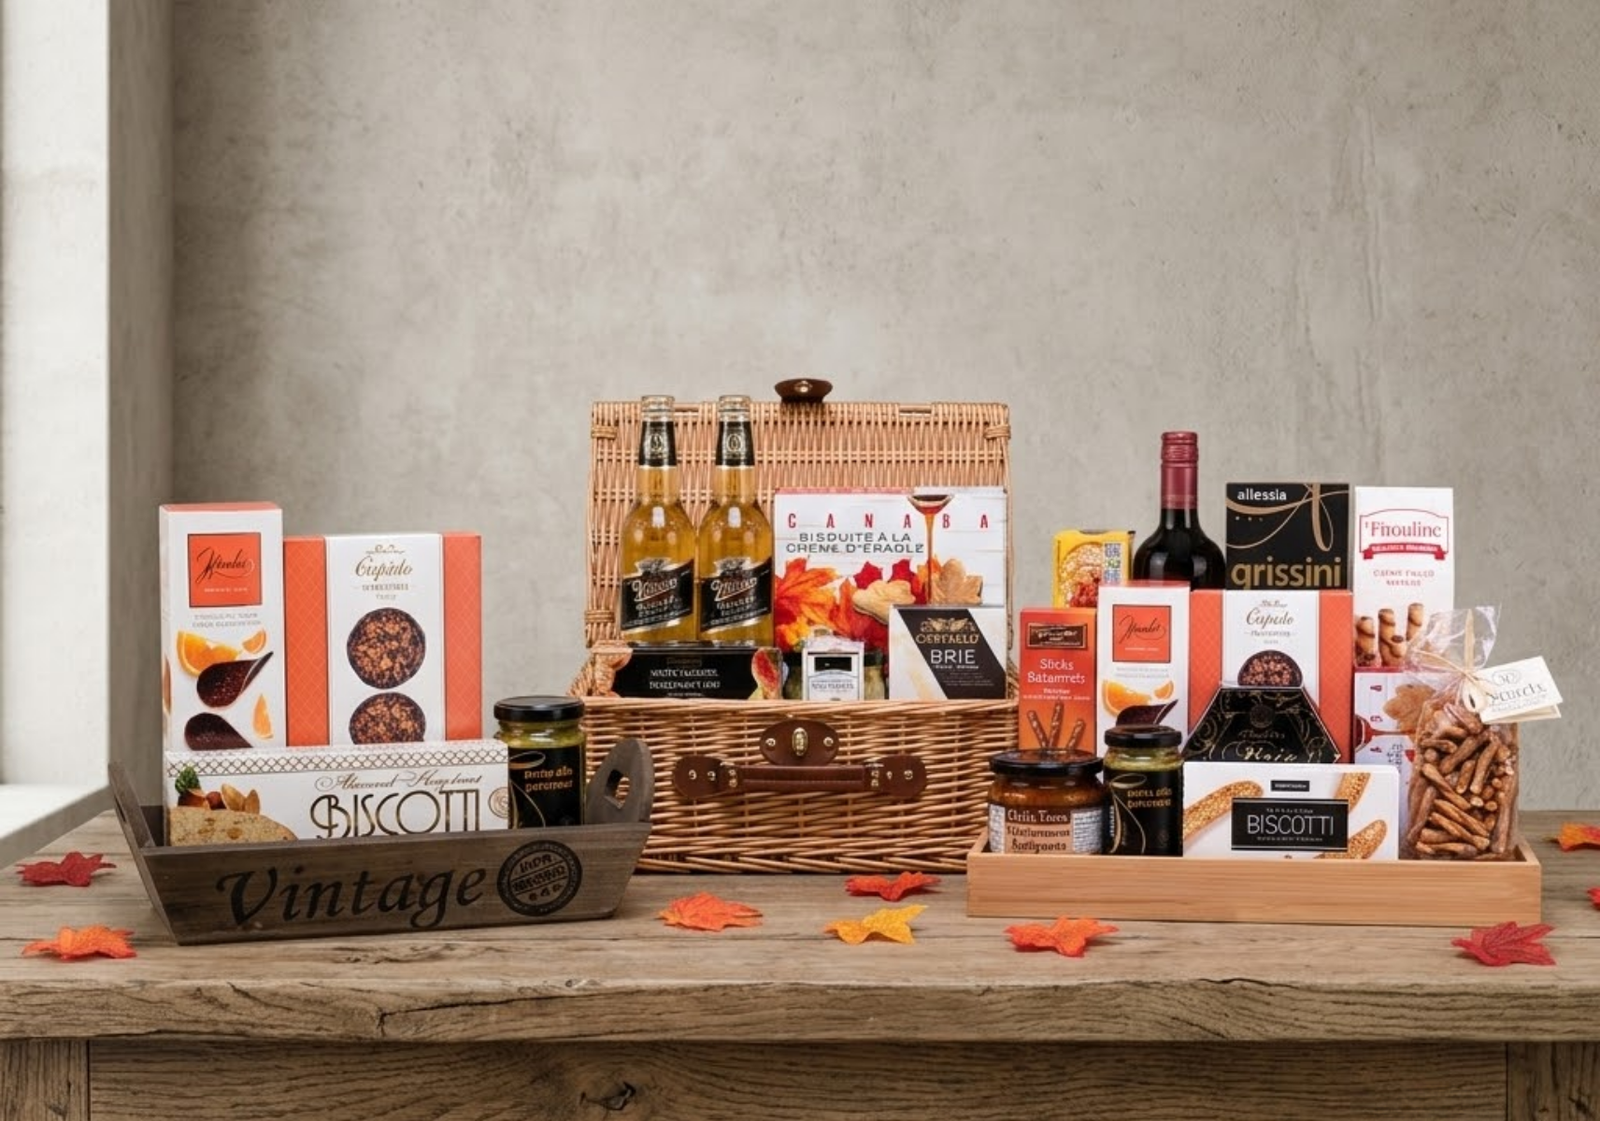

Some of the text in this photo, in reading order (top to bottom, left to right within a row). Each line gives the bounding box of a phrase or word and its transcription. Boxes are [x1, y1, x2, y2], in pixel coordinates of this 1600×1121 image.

[1237, 488, 1287, 500] allessia
[1231, 557, 1342, 590] grissini
[930, 649, 976, 664] BRIE
[310, 788, 480, 839] BISCOTTI
[1247, 814, 1334, 836] BISCOTTI
[216, 866, 487, 928] Vintage
